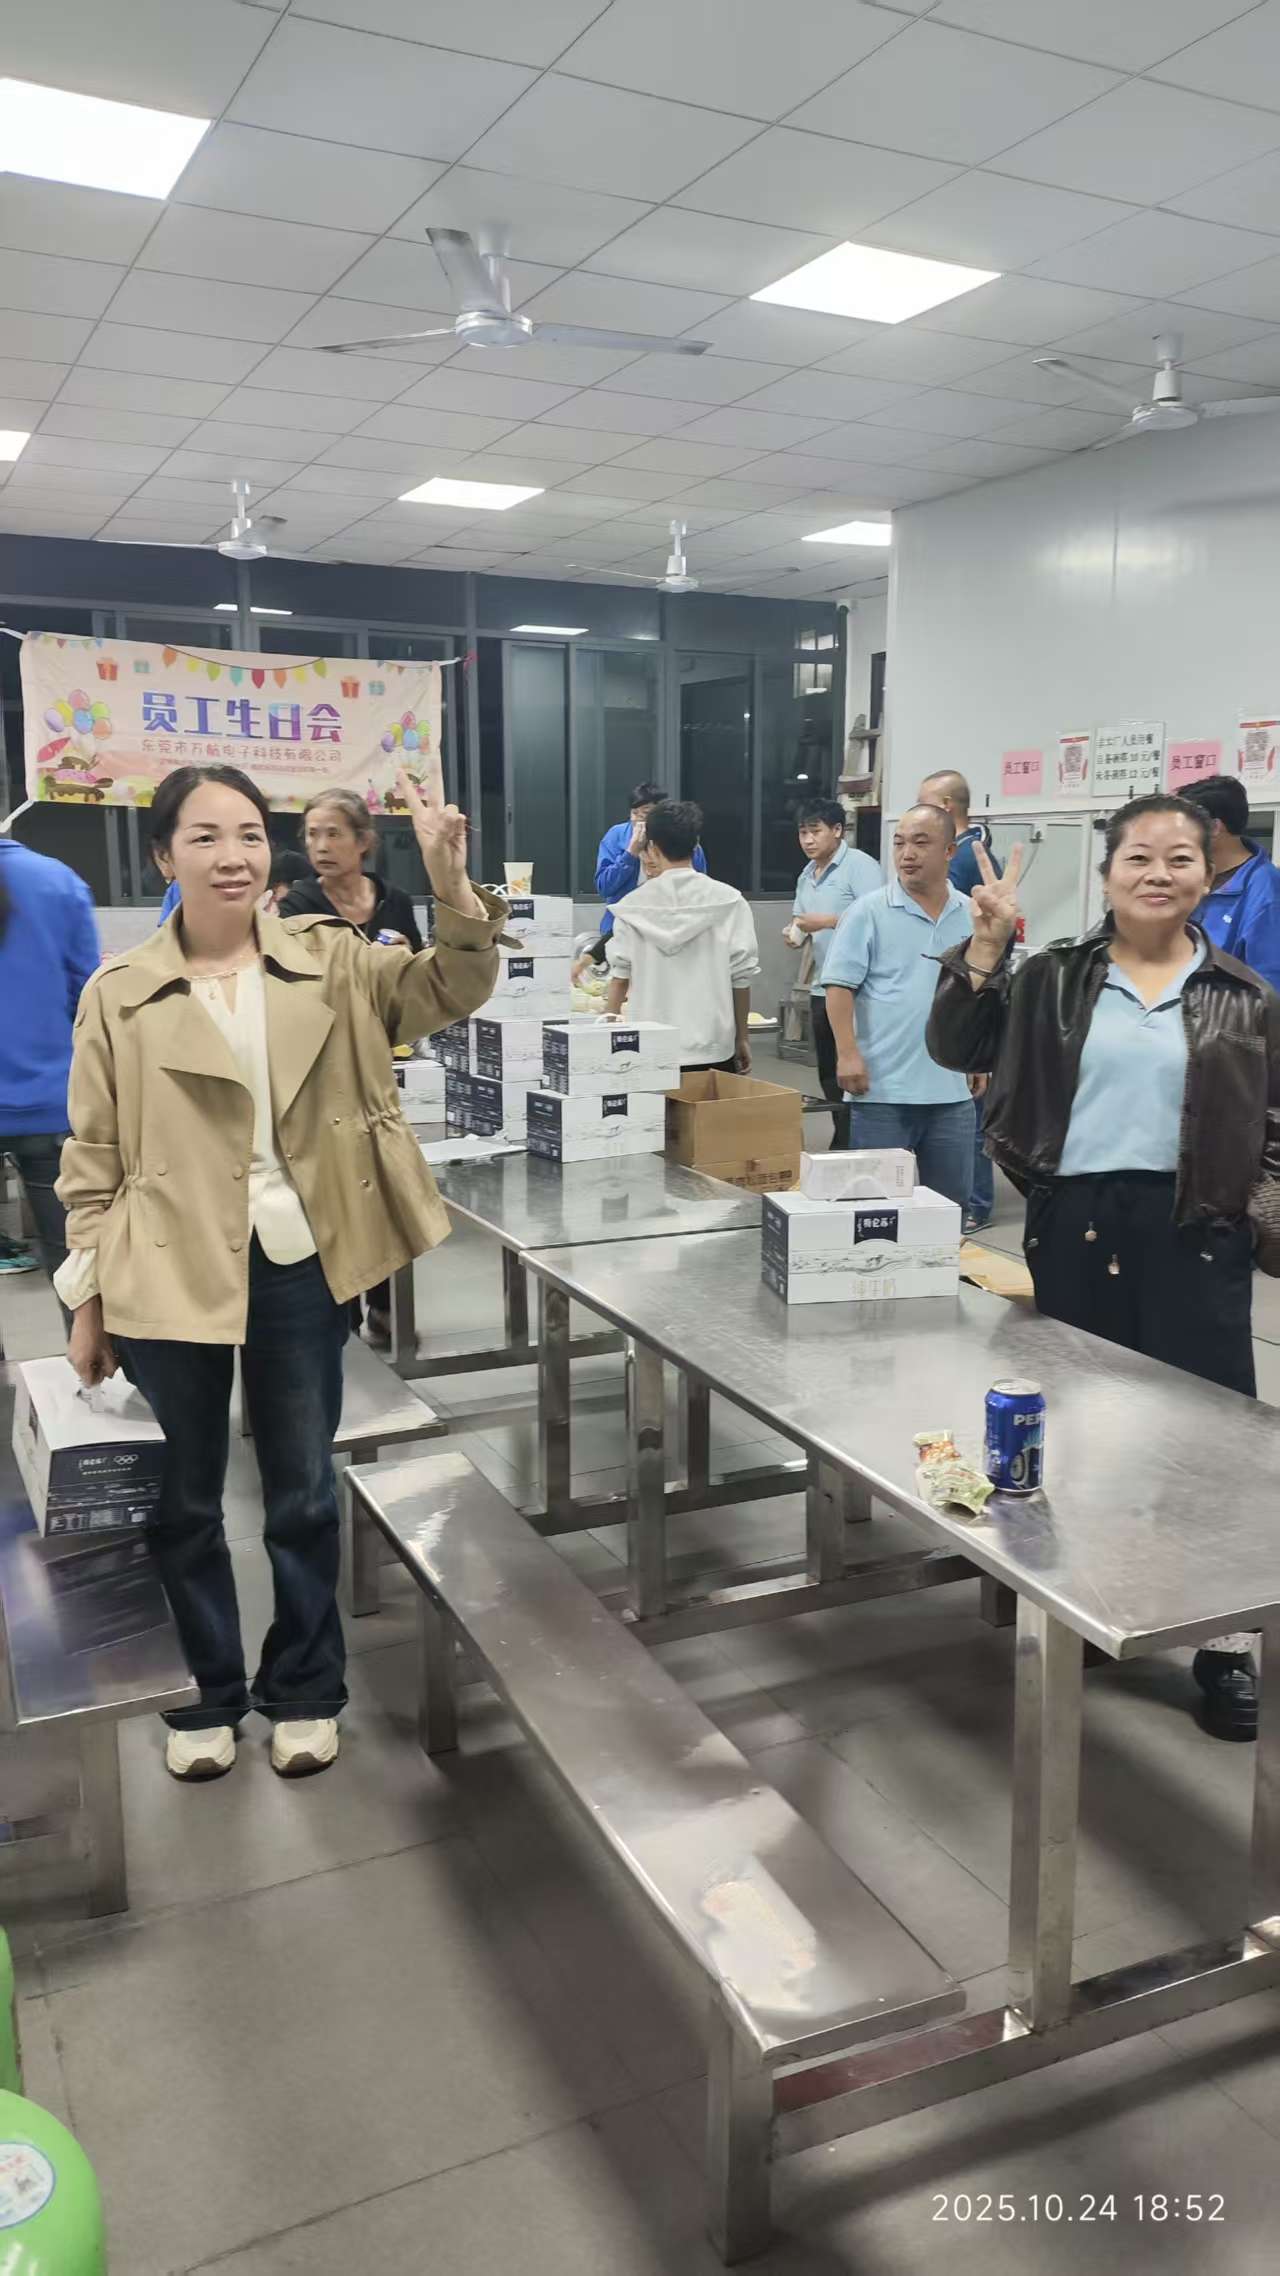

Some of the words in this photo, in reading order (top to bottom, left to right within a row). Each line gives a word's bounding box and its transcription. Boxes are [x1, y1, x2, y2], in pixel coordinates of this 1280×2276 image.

[142, 691, 342, 742] 员工生日会
[1002, 761, 1041, 775] 员工窗口
[1170, 754, 1217, 771] 员工窗口
